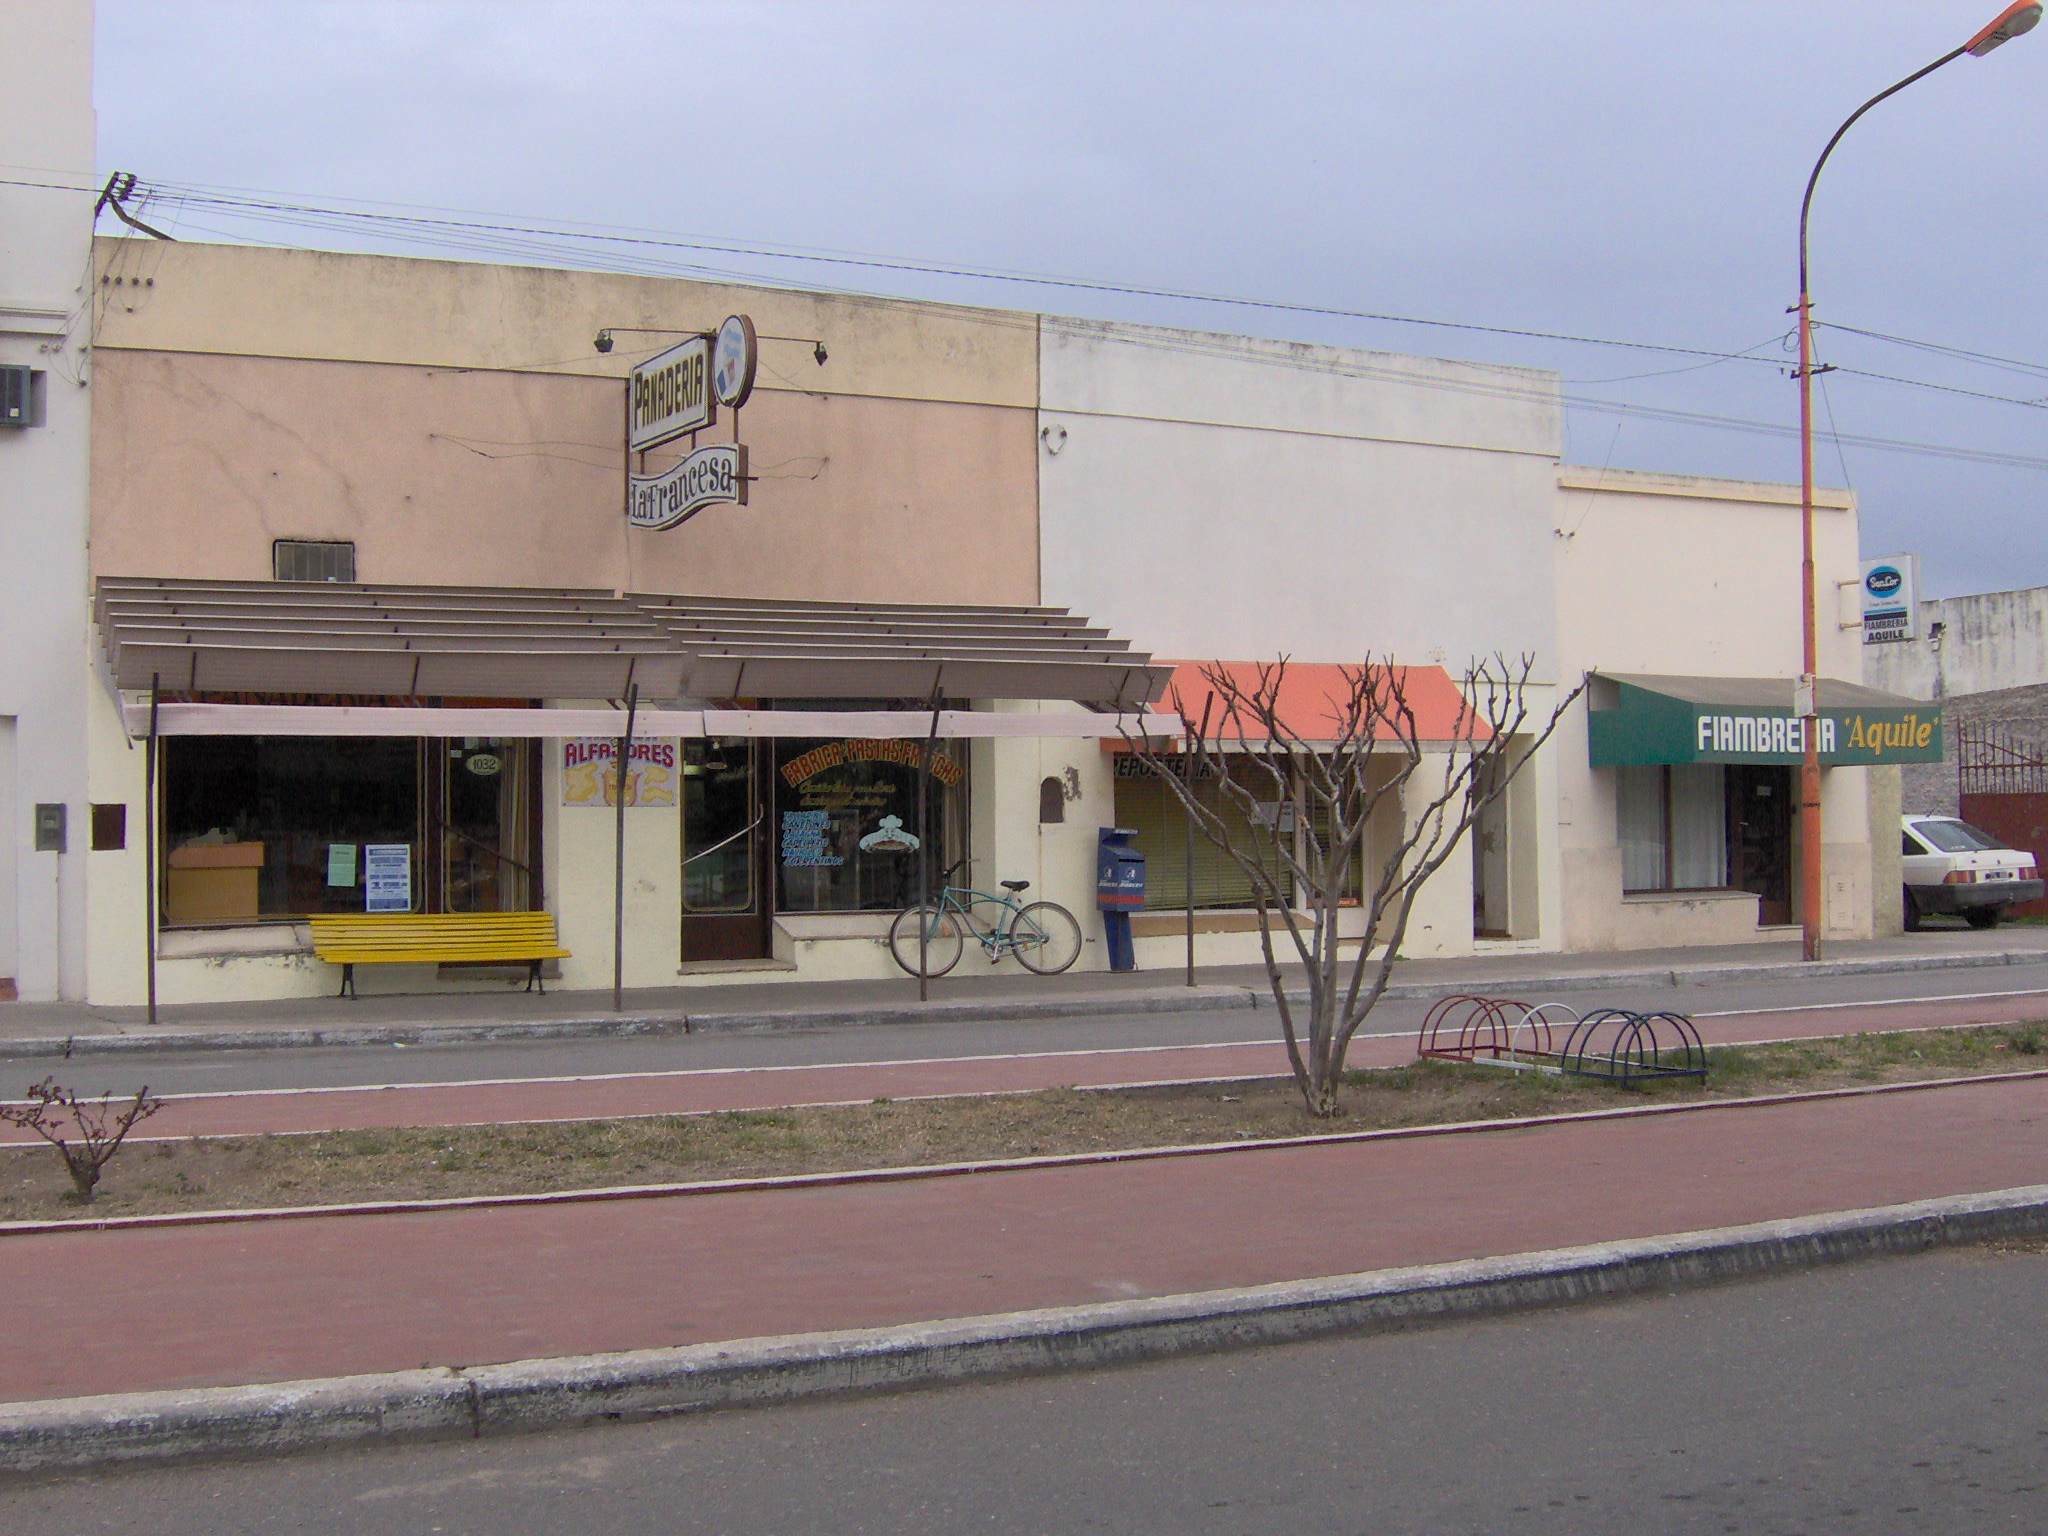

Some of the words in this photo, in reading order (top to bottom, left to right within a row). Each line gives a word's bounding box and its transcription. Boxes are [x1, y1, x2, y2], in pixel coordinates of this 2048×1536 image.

[634, 353, 704, 431] PANADERIA
[1864, 618, 1908, 630] FIAMBRERIA
[1868, 629, 1905, 642] AQUILE
[473, 758, 497, 770] 1032
[780, 743, 845, 789] FABRICA
[845, 738, 902, 763] PASTAS
[900, 742, 962, 787] FRCAS
